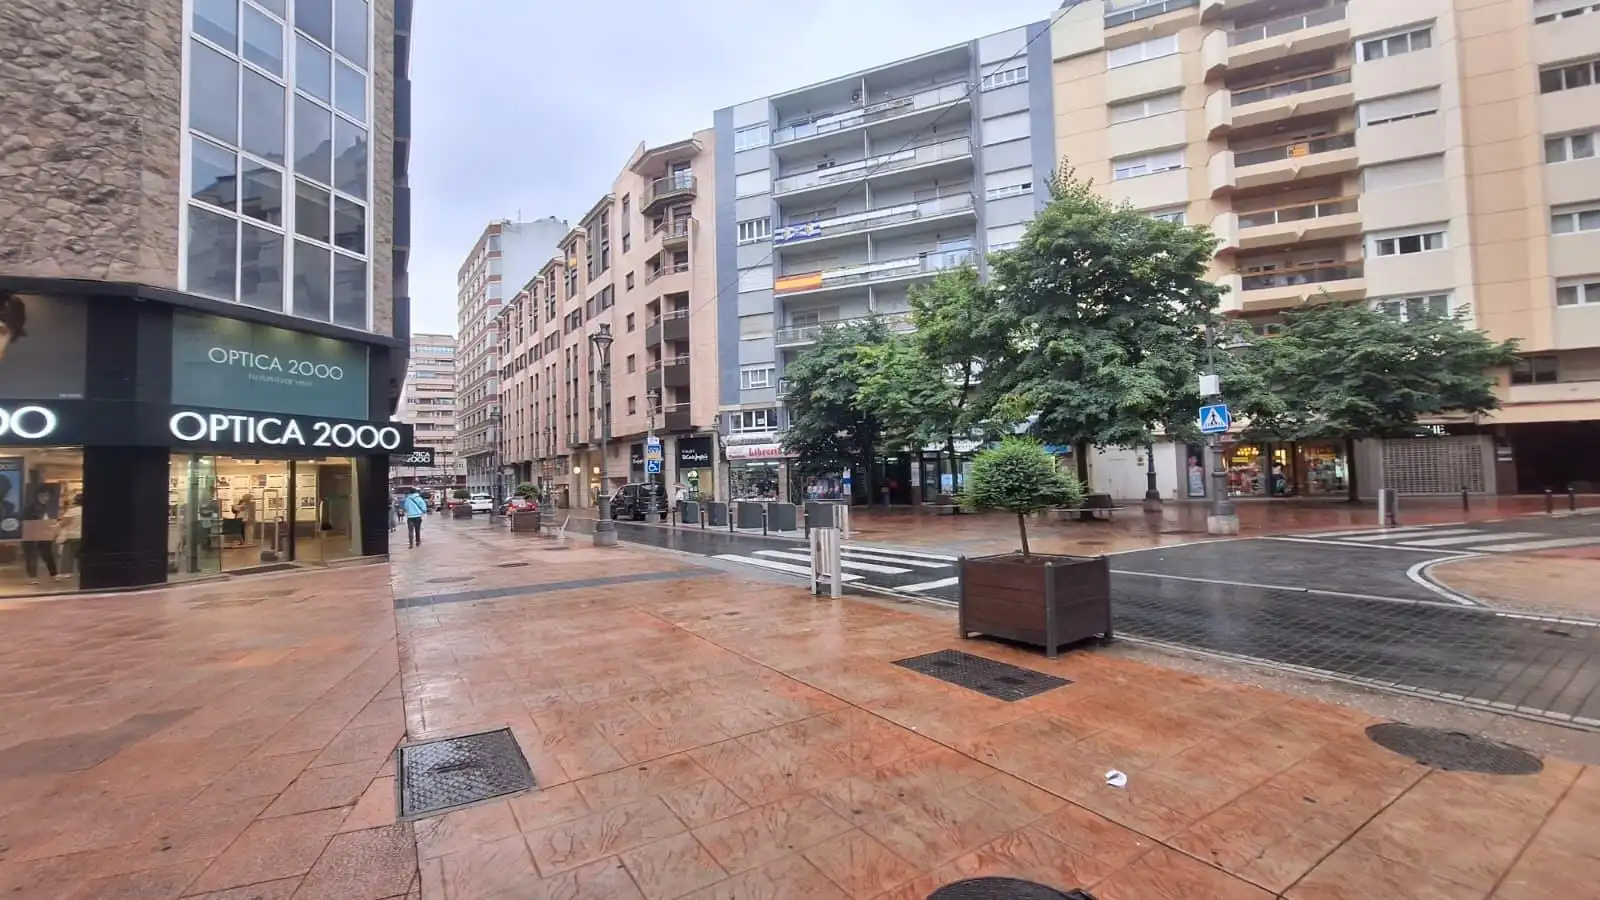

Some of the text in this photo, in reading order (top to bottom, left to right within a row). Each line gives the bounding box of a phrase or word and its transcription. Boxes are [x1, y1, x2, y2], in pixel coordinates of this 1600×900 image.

[208, 347, 282, 372] OPTICA
[288, 359, 344, 381] 2000
[169, 411, 401, 450] OPTICA 2000
